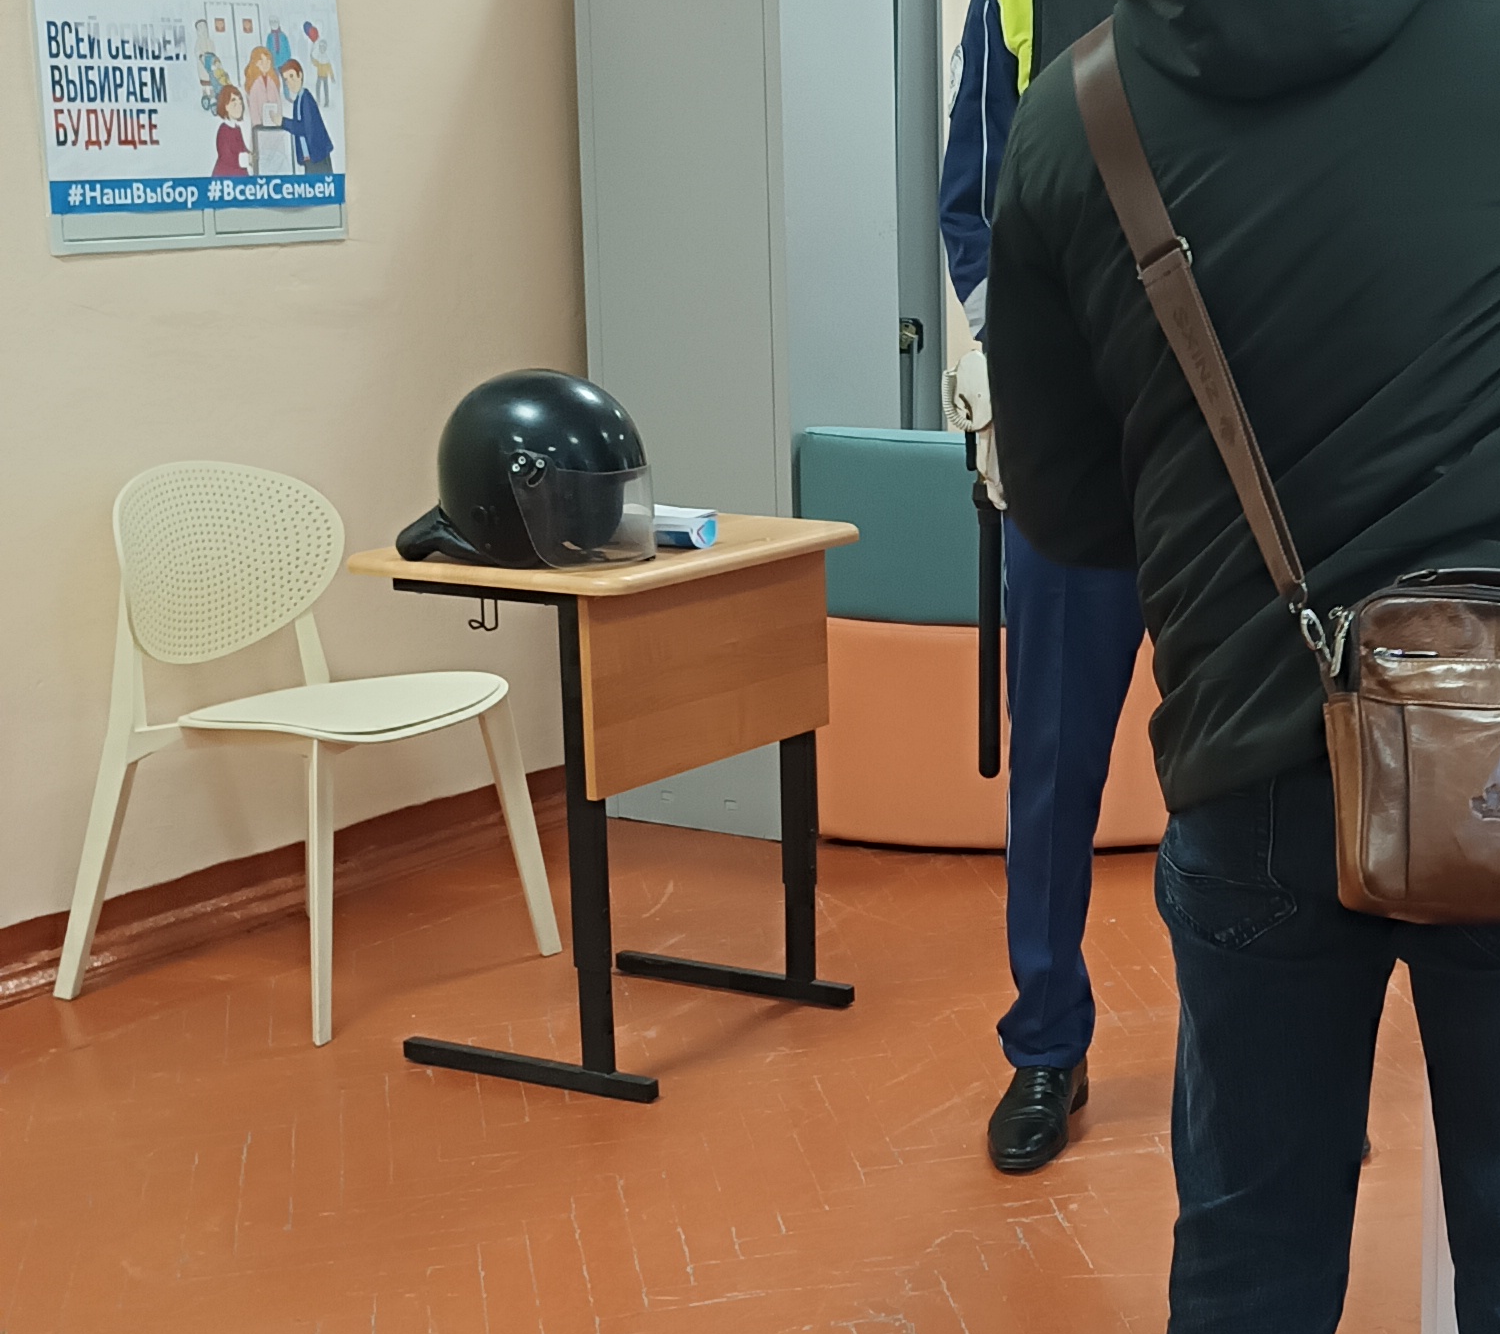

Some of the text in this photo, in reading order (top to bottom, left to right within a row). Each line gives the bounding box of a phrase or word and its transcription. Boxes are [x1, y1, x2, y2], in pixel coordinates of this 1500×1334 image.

[46, 16, 102, 59] ВСЕЙ
[50, 65, 167, 103] ВЫБИРАЕМ
[54, 109, 160, 150] БУДУЩЕЕ
[68, 176, 335, 208] #НашВыбор #ВсейСемьей
